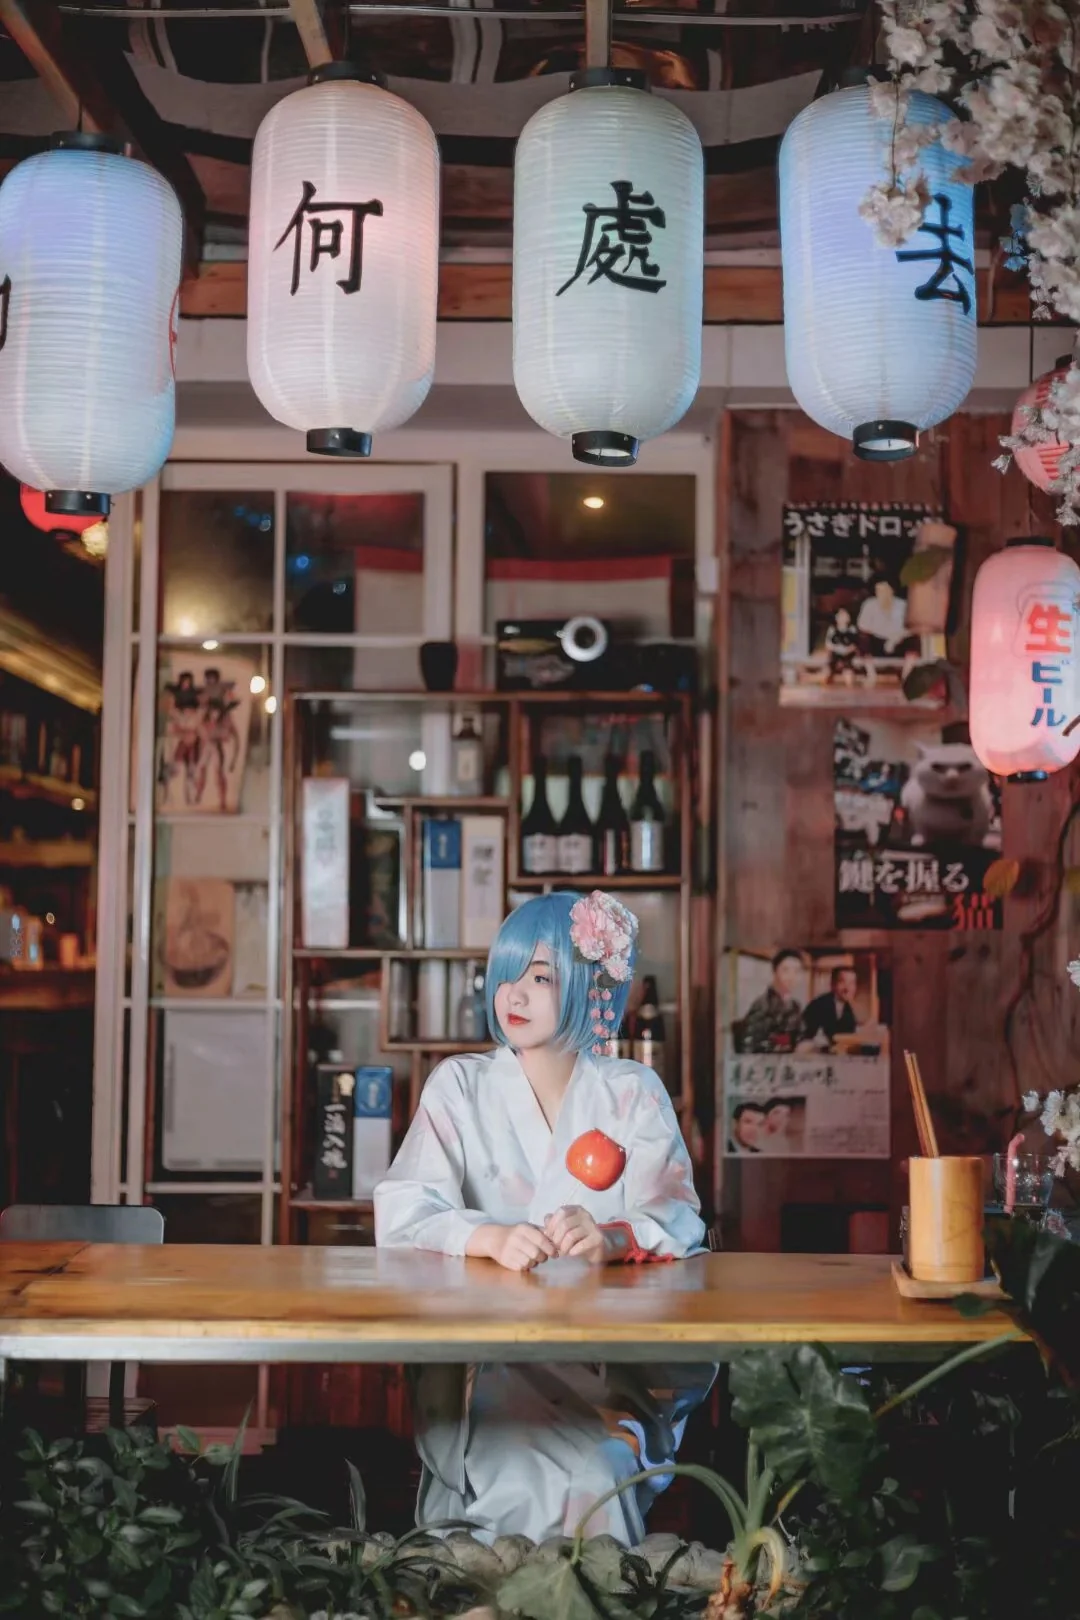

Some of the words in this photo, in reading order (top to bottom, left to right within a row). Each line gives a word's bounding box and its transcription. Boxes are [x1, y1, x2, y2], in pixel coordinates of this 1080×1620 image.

[272, 180, 384, 296] 何
[555, 180, 667, 296] 處
[895, 192, 974, 316] 去
[784, 510, 944, 538] うさぎドロッ
[1024, 602, 1072, 727] 生ビール
